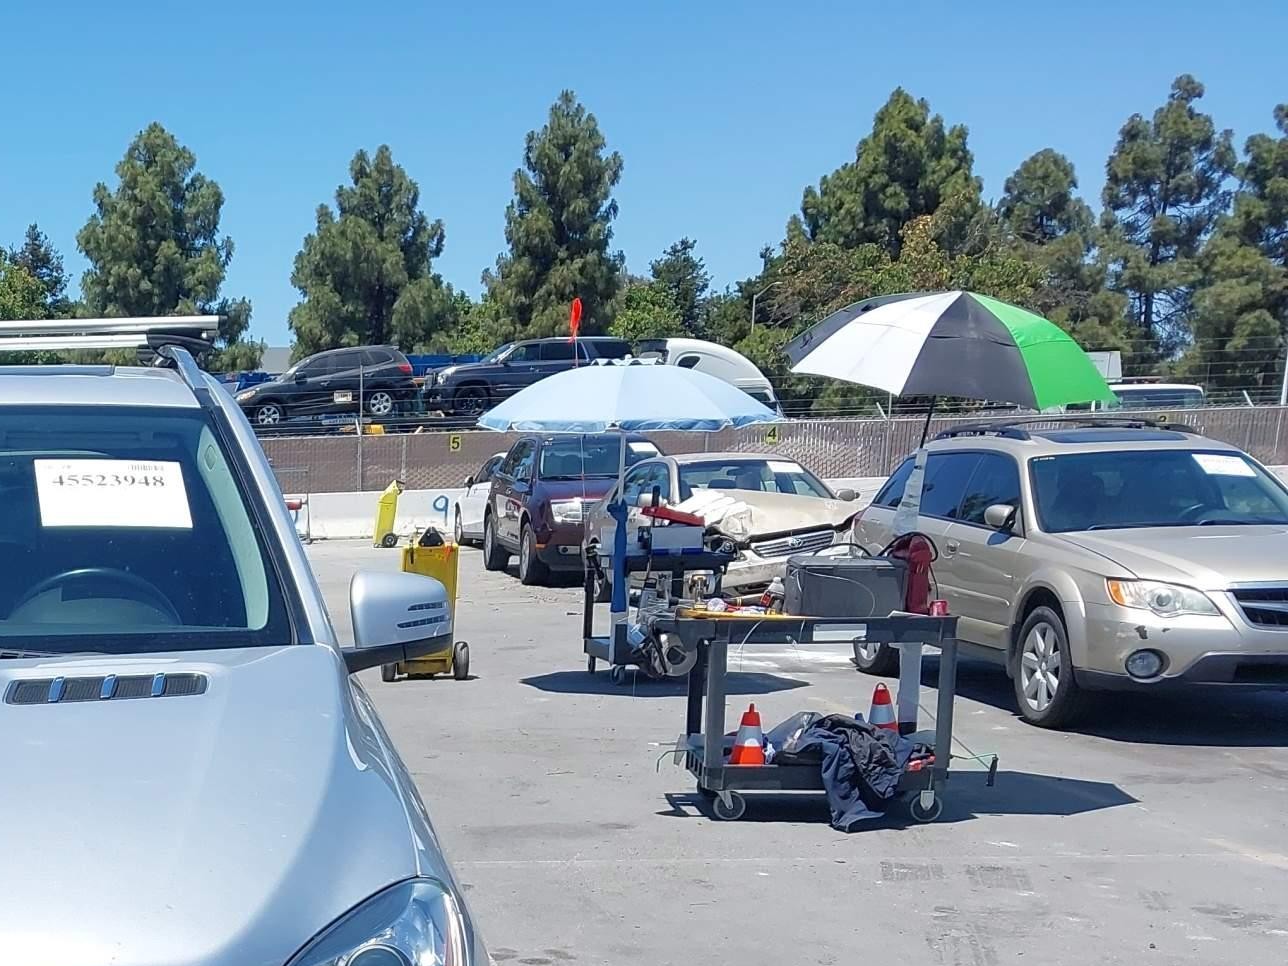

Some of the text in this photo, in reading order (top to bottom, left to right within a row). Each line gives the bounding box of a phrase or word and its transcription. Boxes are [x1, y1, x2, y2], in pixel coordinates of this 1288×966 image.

[767, 426, 776, 440] 4
[451, 436, 460, 450] 5
[52, 474, 165, 487] 45523948
[433, 495, 449, 527] 9
